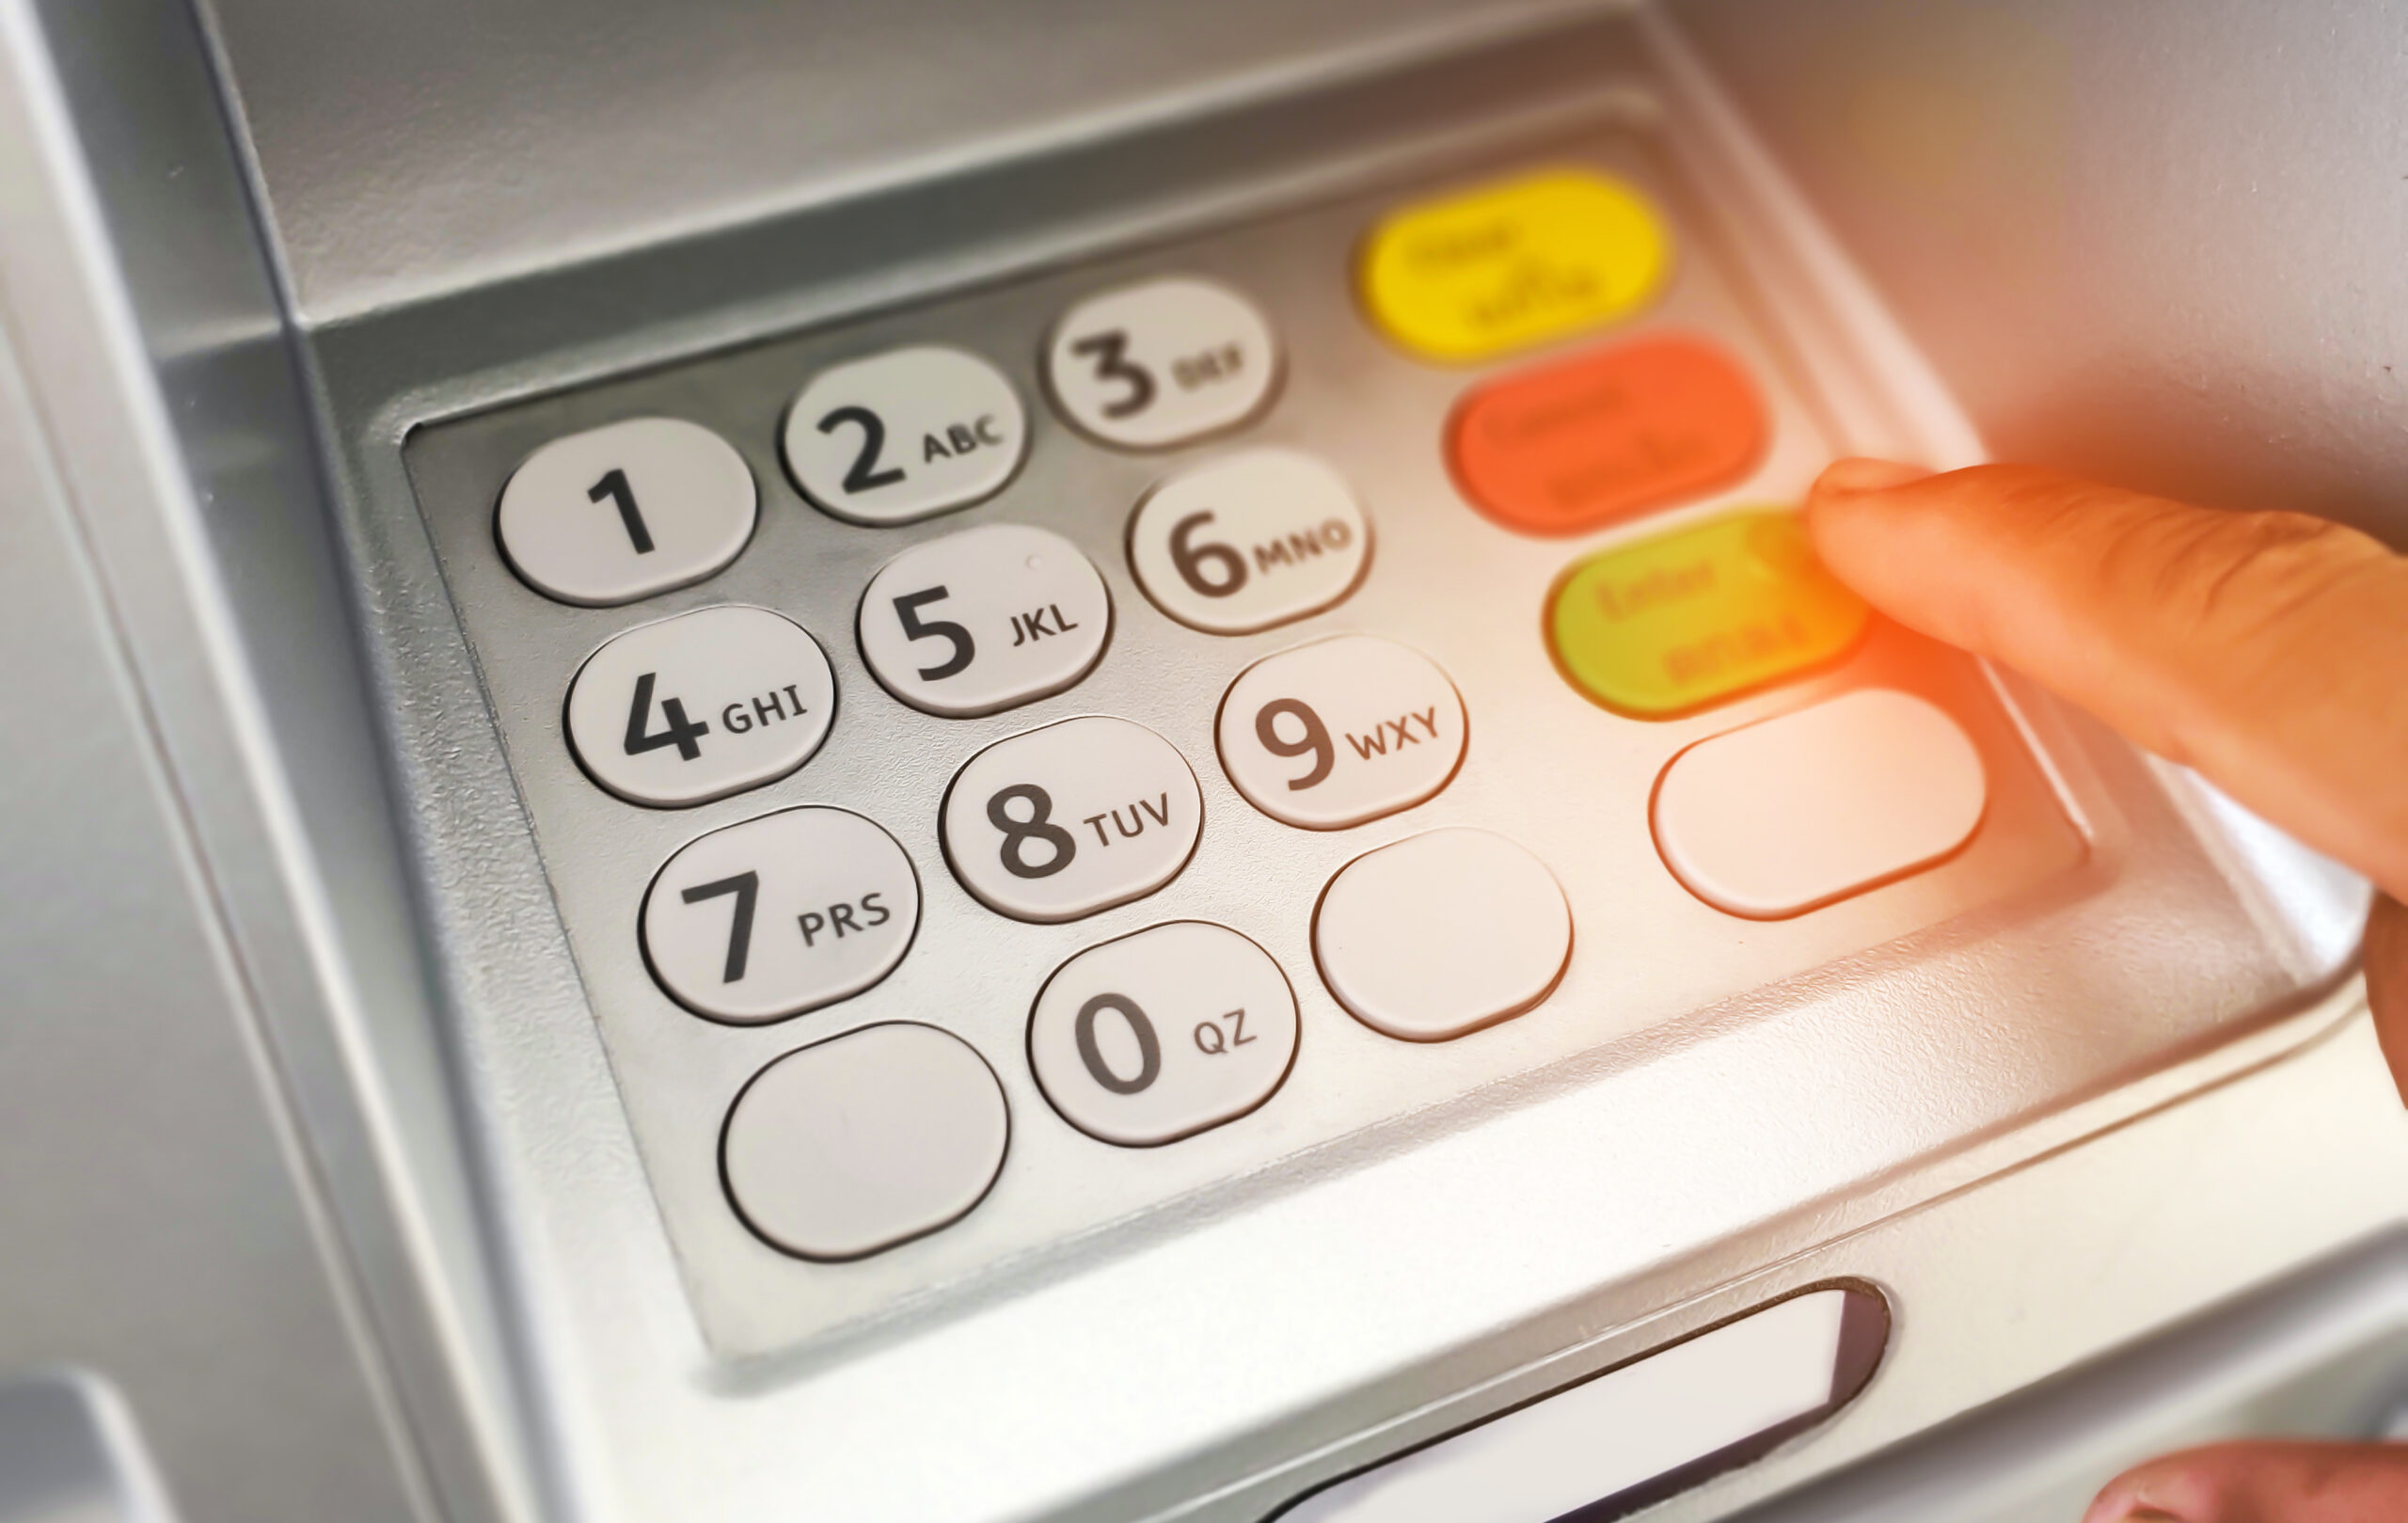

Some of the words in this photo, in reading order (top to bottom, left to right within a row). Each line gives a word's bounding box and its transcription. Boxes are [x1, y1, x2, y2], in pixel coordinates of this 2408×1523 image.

[1070, 329, 1157, 419] 3
[816, 406, 906, 496] 2
[923, 415, 1005, 464] ABC
[588, 468, 655, 554] 1
[1169, 511, 1247, 597] 6
[1254, 517, 1354, 576] MNO
[893, 586, 975, 682] 5
[1011, 605, 1078, 646] JKL
[624, 673, 709, 761] 4
[722, 685, 807, 734] GHI
[1256, 699, 1335, 791] 9
[1345, 707, 1437, 760] WXY
[987, 784, 1076, 879] 8
[1084, 793, 1168, 847] TUV
[681, 871, 759, 983] 7
[798, 893, 890, 946] PRS
[1075, 993, 1161, 1095] 0
[1194, 1009, 1257, 1055] QZ
